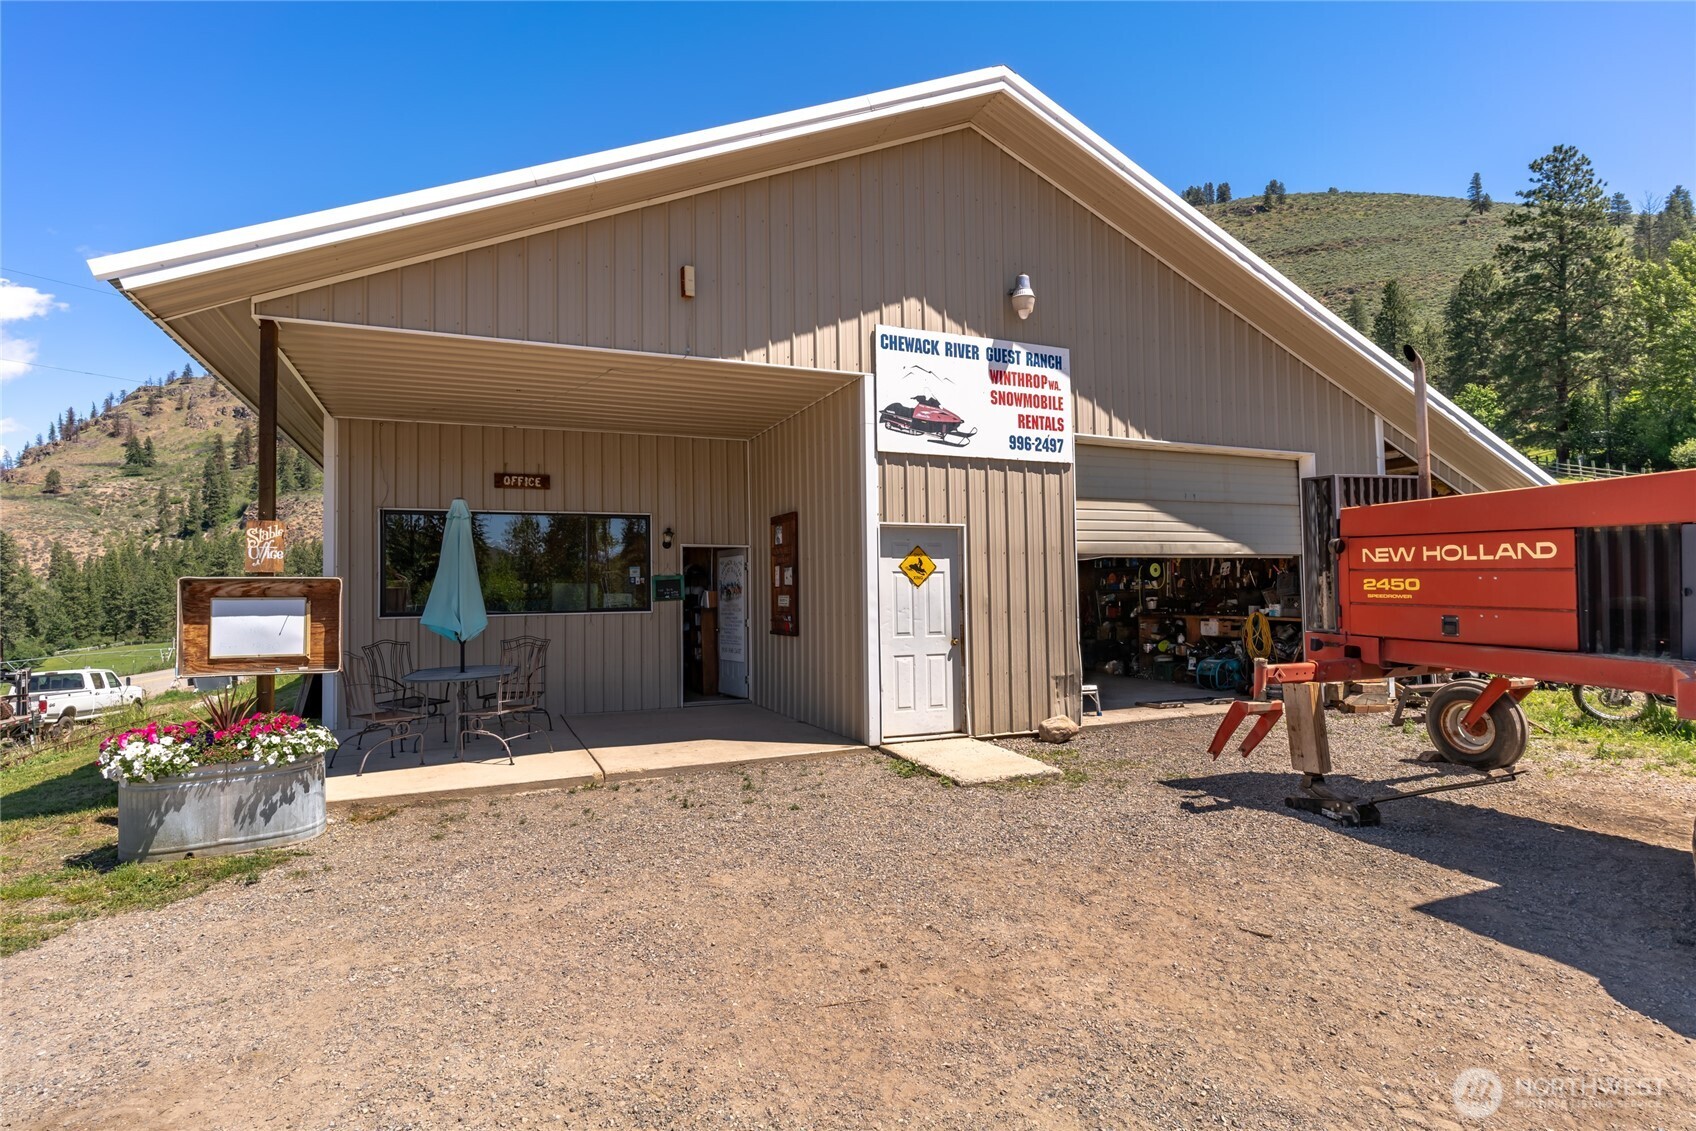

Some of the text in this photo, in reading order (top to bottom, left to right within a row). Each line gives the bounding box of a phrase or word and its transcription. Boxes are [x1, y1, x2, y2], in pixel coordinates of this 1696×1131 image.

[880, 333, 1063, 371] CHEWACK RIVER GUEST RANCH
[989, 369, 1048, 391] WINTHROP
[990, 390, 1064, 412] SNOWMOBILE
[1017, 414, 1065, 432] RENTALS
[1008, 435, 1064, 454] 996-2497
[503, 475, 541, 487] OFFICE
[246, 524, 284, 549] Stable
[247, 539, 284, 566] Office
[1361, 541, 1558, 563] NEW HOLLAND
[1363, 578, 1421, 592] 2450
